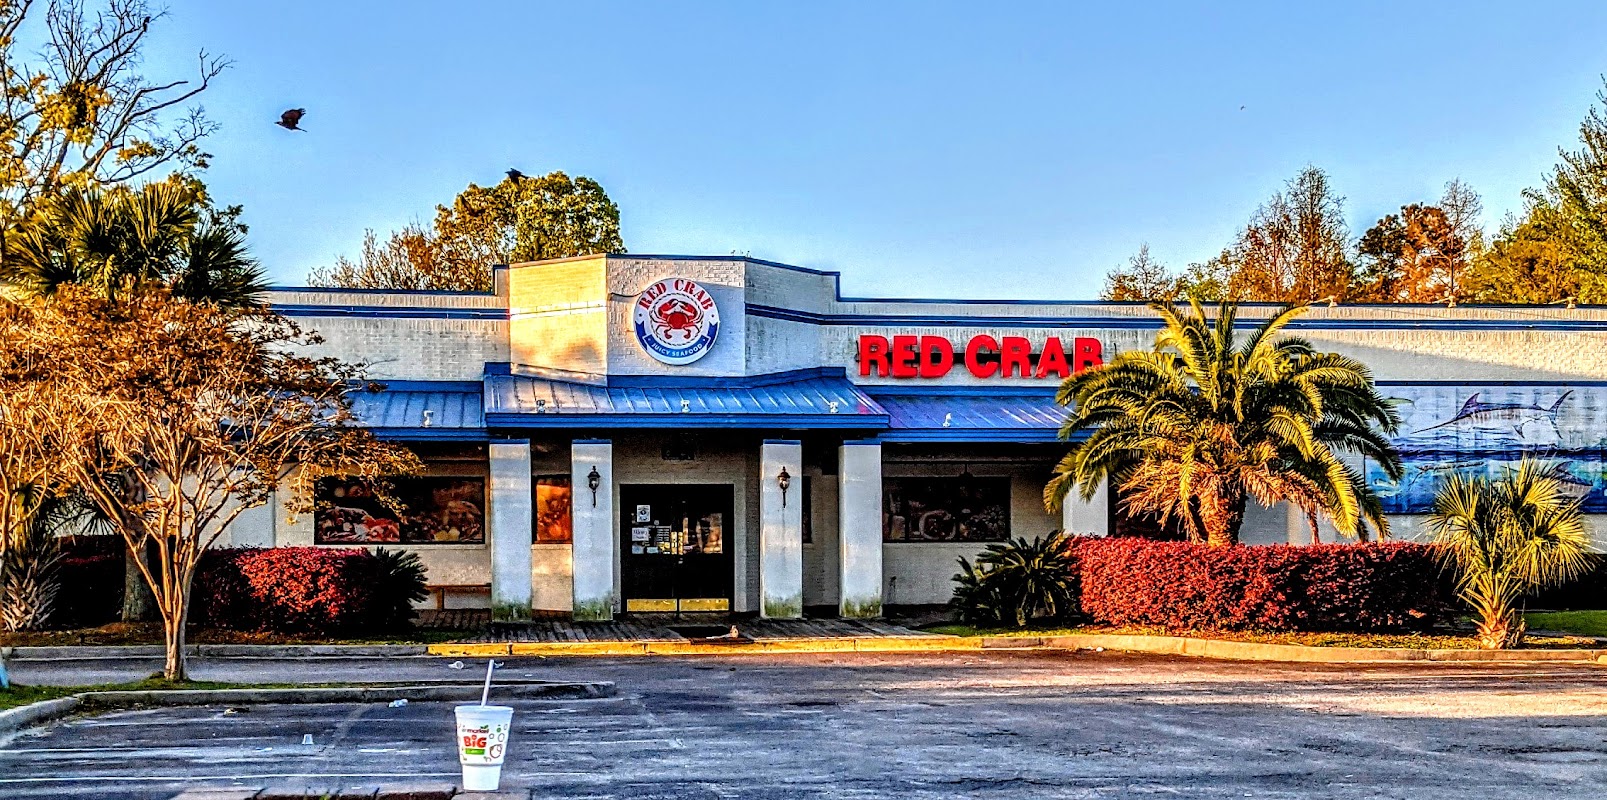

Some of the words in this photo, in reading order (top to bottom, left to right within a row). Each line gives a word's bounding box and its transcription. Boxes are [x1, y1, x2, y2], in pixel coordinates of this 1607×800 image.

[639, 283, 667, 310] RED
[674, 279, 713, 310] CRAB
[652, 343, 670, 355] JUICY
[672, 344, 702, 356] SEAFOOD
[858, 335, 954, 378] RED
[964, 335, 1103, 378] CRAB
